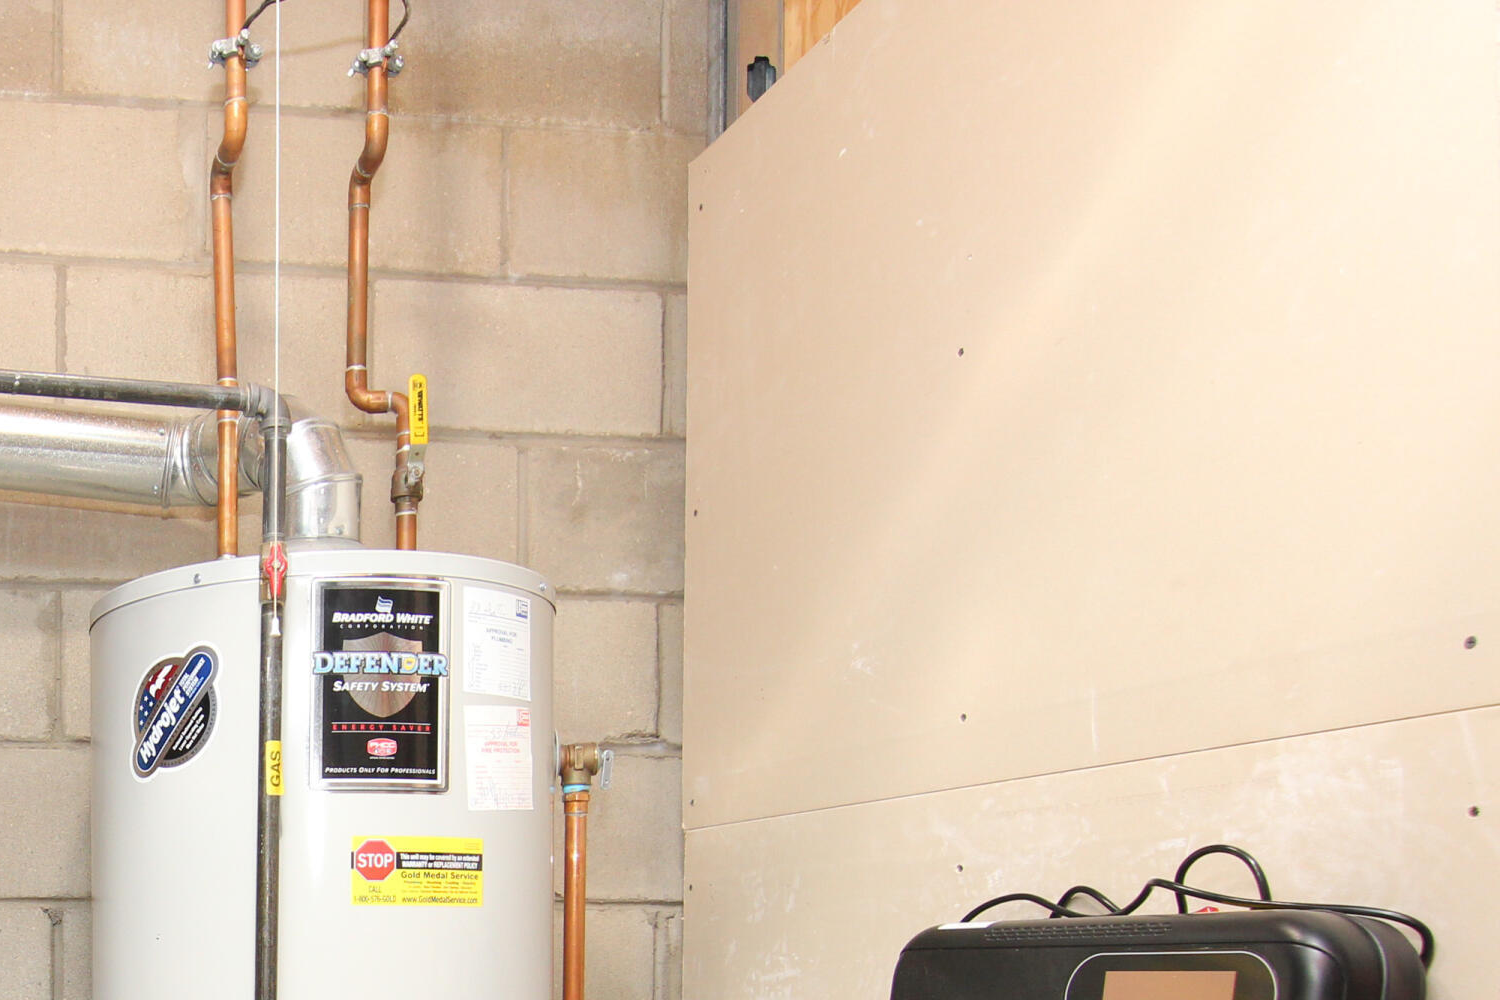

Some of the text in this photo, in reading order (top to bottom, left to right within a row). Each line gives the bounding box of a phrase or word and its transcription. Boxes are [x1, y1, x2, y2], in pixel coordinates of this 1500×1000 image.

[332, 612, 431, 625] BRADFORD WHITE
[313, 652, 448, 676] DEFENDER
[333, 681, 428, 693] SAFETY SYSTEM
[140, 685, 185, 764] Hydrojet
[392, 724, 431, 732] SAVER
[270, 751, 281, 787] GAS
[390, 767, 436, 775] PROFESSIONALS
[357, 853, 393, 868] STOP
[401, 871, 420, 879] Gold
[450, 872, 478, 880] Service
